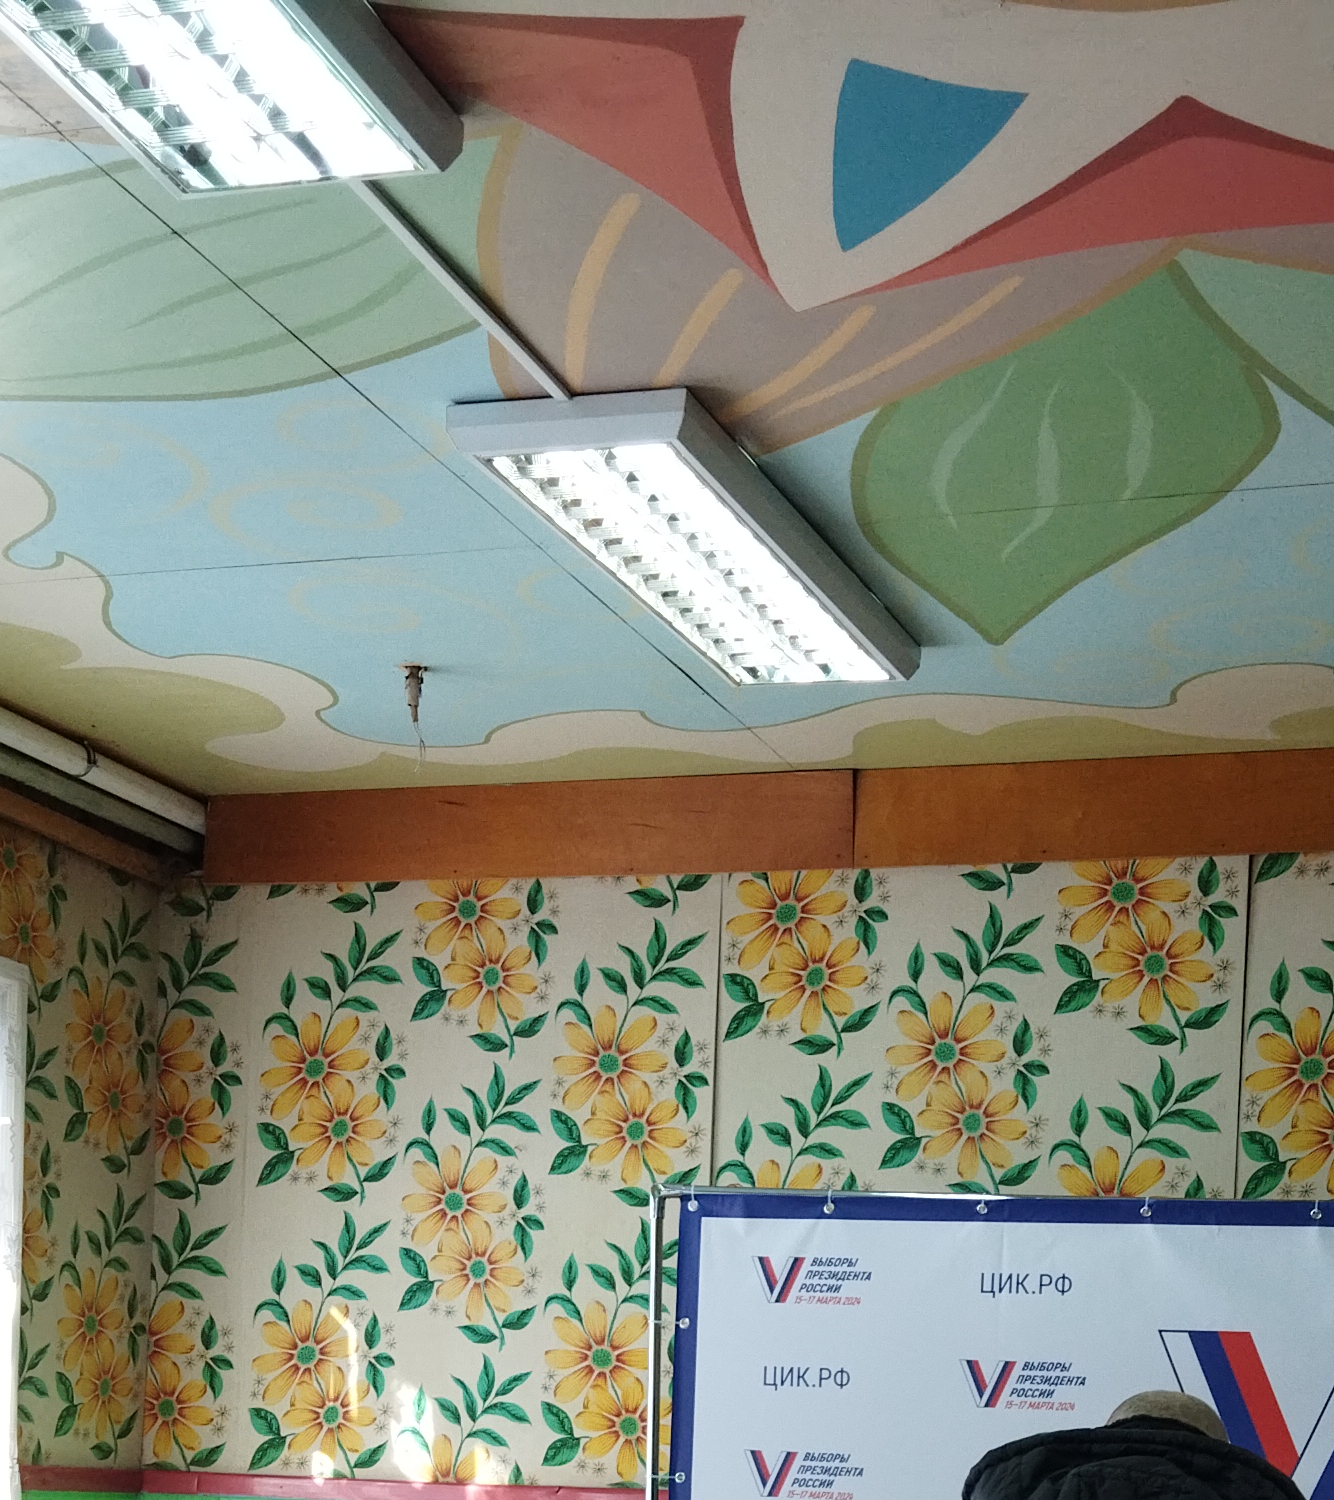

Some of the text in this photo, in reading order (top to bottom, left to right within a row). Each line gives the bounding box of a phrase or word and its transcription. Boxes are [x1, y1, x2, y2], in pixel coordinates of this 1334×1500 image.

[810, 1257, 859, 1268] ВЫБОРЫ
[805, 1271, 872, 1282] ПРЕЗИДЕНТА
[799, 1284, 843, 1294] РОССИИ
[980, 1272, 1073, 1299] ЦИК.РФ
[816, 1296, 841, 1305] МАРТА
[843, 1297, 861, 1306] 2024
[1021, 1362, 1073, 1372] ВЫБОРЫ
[763, 1365, 851, 1391] ЦИК.РФ
[1015, 1375, 1087, 1386] ПРЕЗИДЕНТА
[1009, 1388, 1055, 1398] РОССИИ
[1027, 1402, 1054, 1410] МАРТА
[1056, 1402, 1075, 1411] 2024
[803, 1453, 851, 1463] ВЫБОРЫ
[797, 1465, 864, 1477] ПРЕЗИДЕНТА
[791, 1478, 835, 1489] РОССИИ
[809, 1491, 833, 1500] МАРТА
[835, 1492, 853, 1500] 2024
